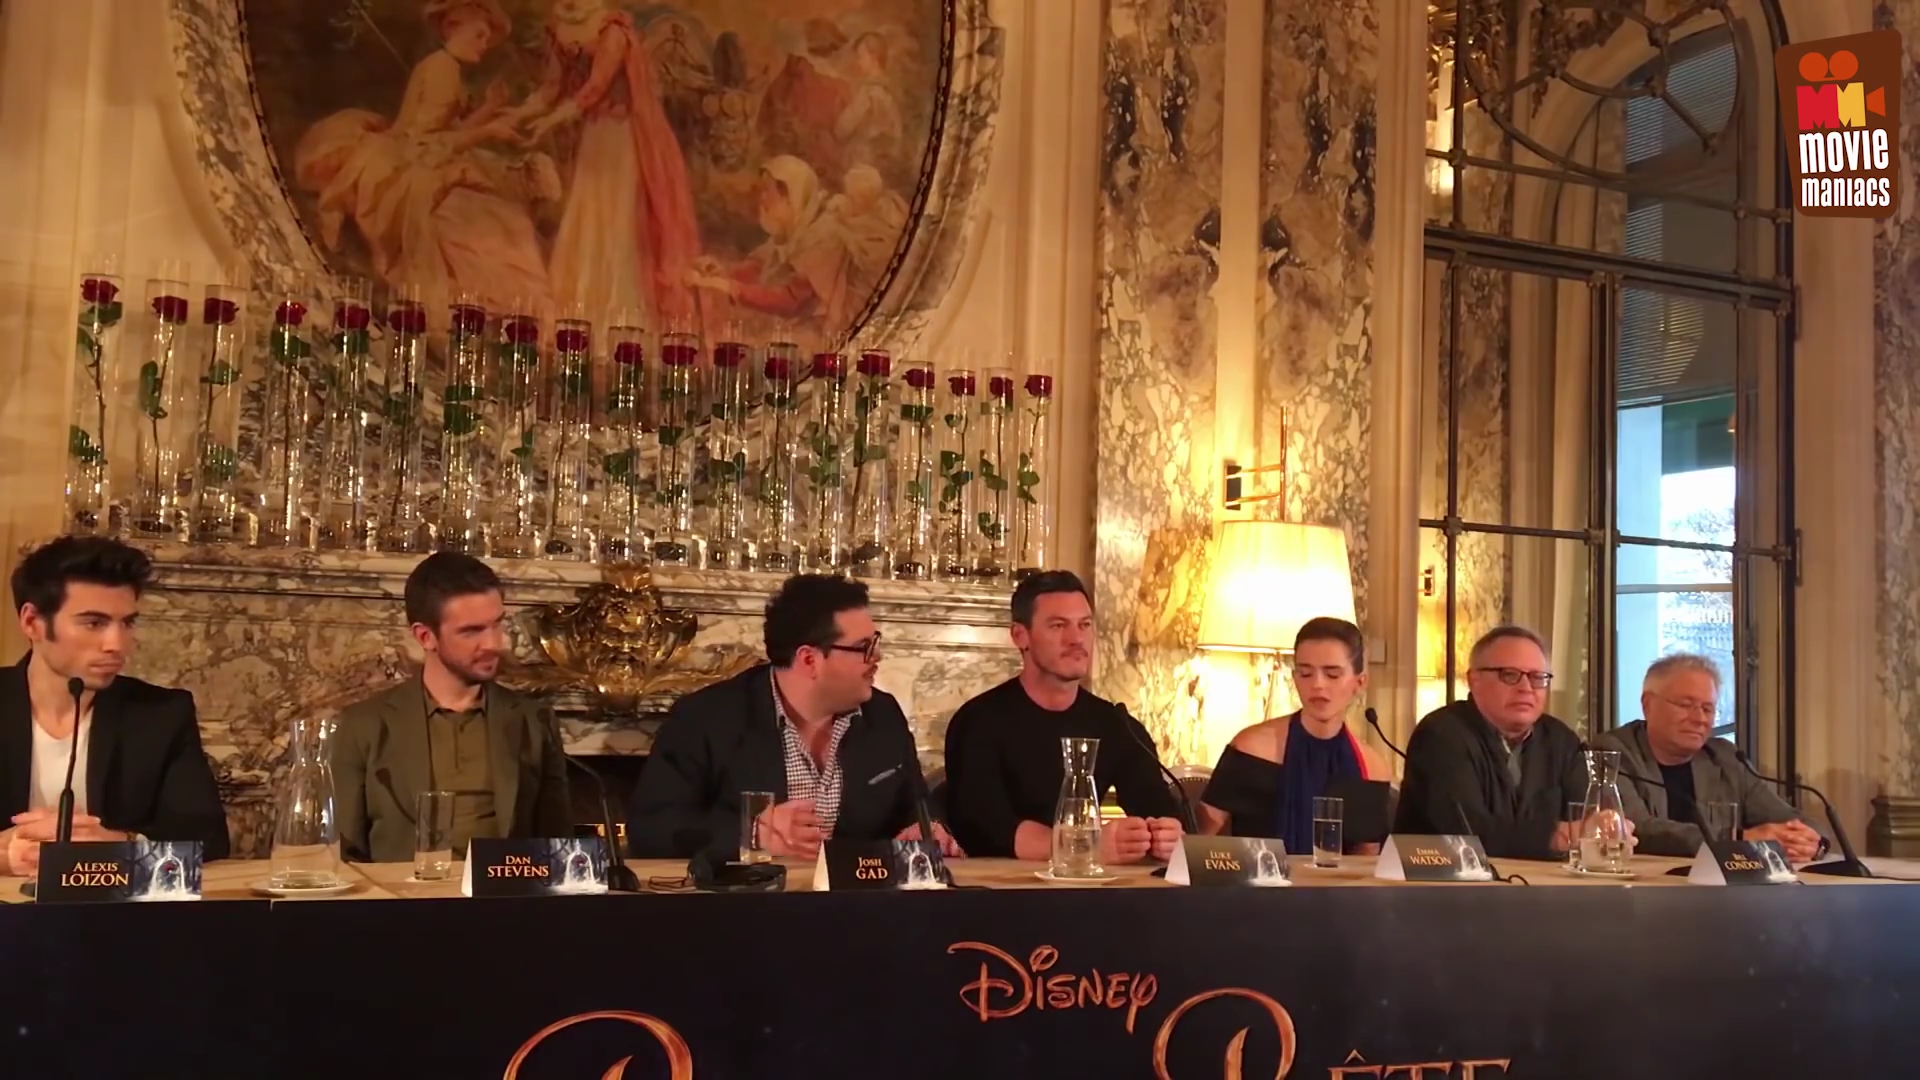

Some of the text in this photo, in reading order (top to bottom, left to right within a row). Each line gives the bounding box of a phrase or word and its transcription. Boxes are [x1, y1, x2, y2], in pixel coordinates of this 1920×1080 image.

[505, 855, 531, 865] DAN
[858, 857, 882, 867] JOSH
[1204, 859, 1241, 871] EVANS
[1409, 855, 1452, 866] WATSON
[1724, 860, 1765, 870] CONDON
[73, 862, 118, 872] ALEXIS
[487, 865, 549, 877] STEVENS
[856, 867, 888, 879] GAD
[61, 873, 129, 887] LOIZON
